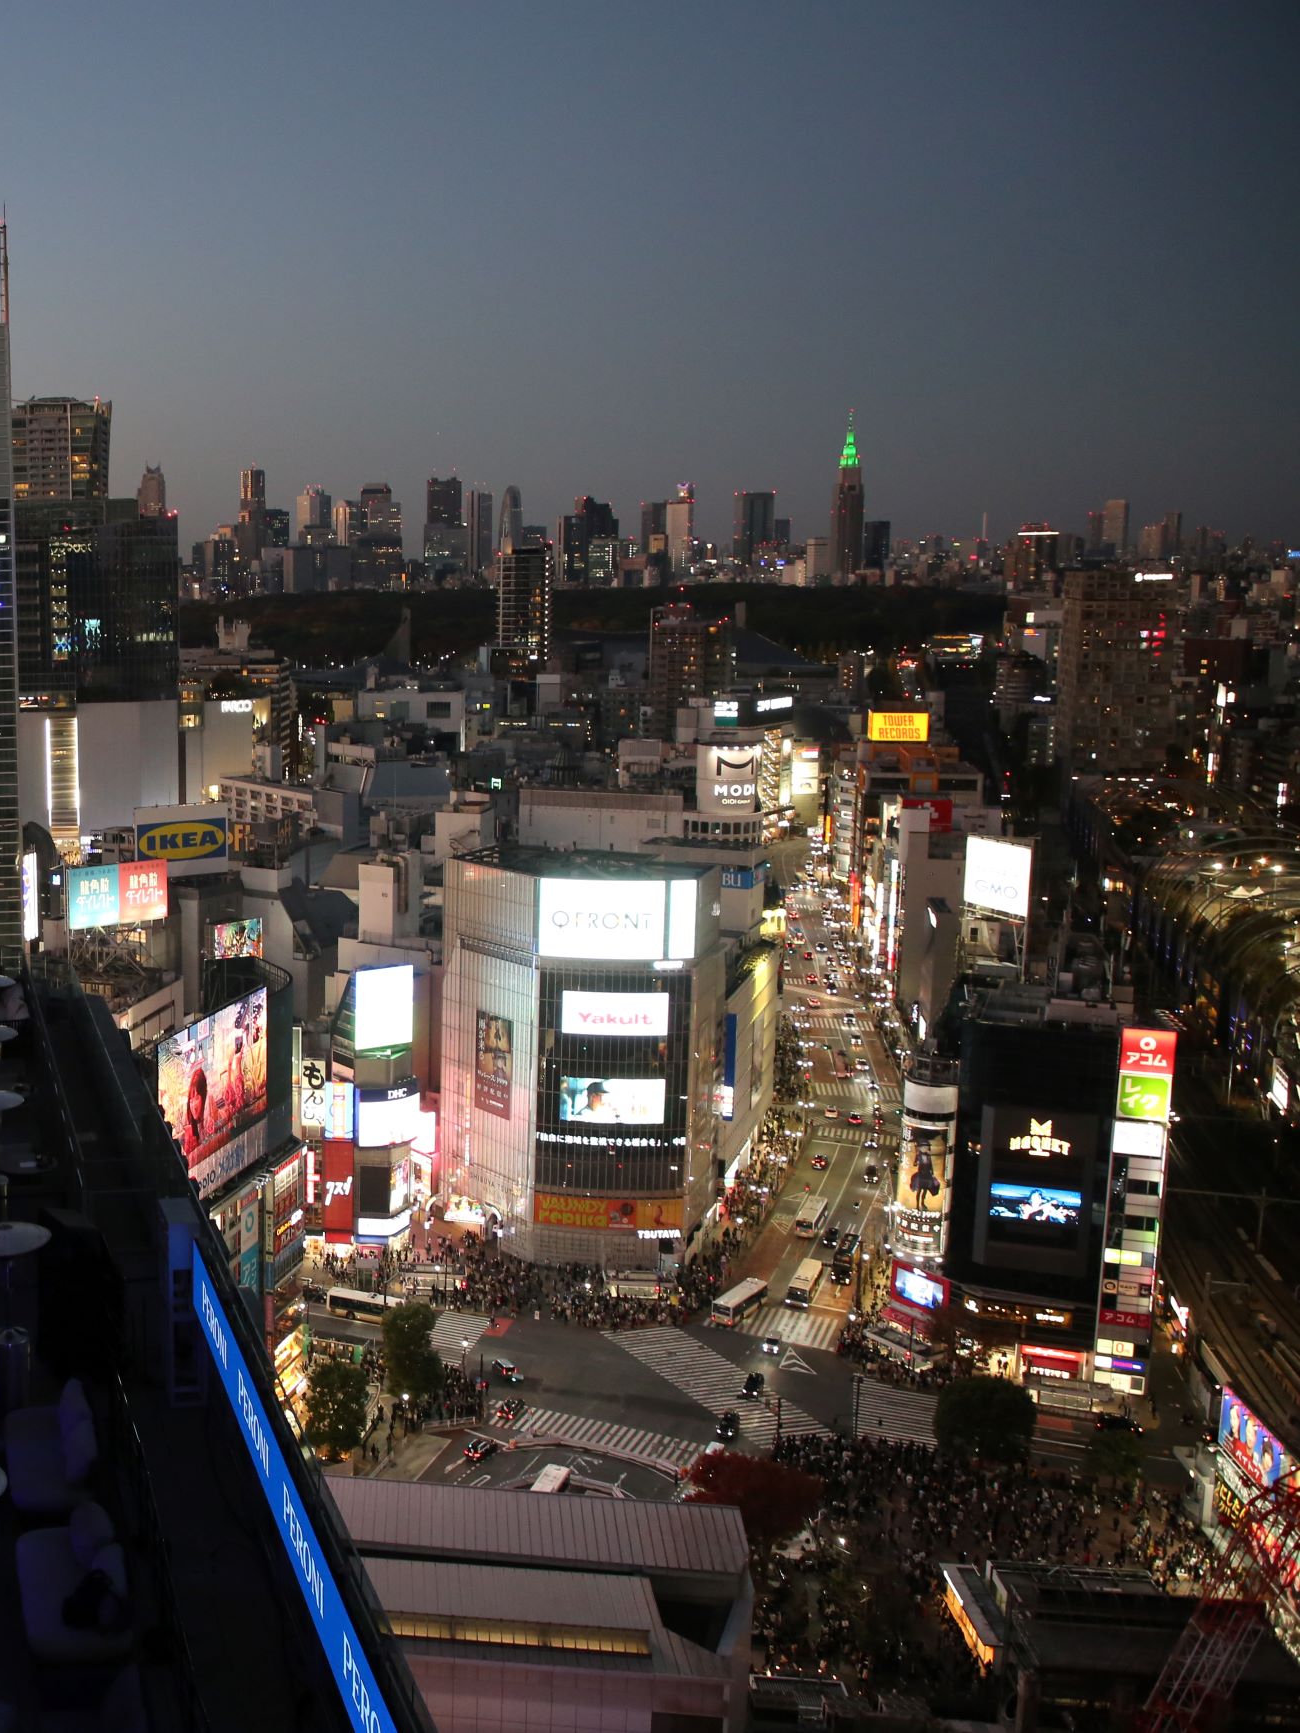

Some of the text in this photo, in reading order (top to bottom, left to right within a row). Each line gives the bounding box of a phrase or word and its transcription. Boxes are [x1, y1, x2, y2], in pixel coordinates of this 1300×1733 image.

[883, 715, 914, 726] TOWER
[879, 728, 920, 739] RECORDS
[714, 784, 756, 797] MODI
[146, 830, 220, 851] IKEA
[975, 880, 1018, 899] GMO
[578, 1011, 653, 1026] Yakult
[1126, 1051, 1168, 1067] アコム
[387, 1087, 408, 1100] DHC
[637, 1229, 682, 1239] TSUTAYA
[202, 1281, 228, 1369] PERONI
[1104, 1312, 1135, 1324] アコム
[238, 1369, 270, 1478] PERONI
[283, 1481, 324, 1619] PERONI
